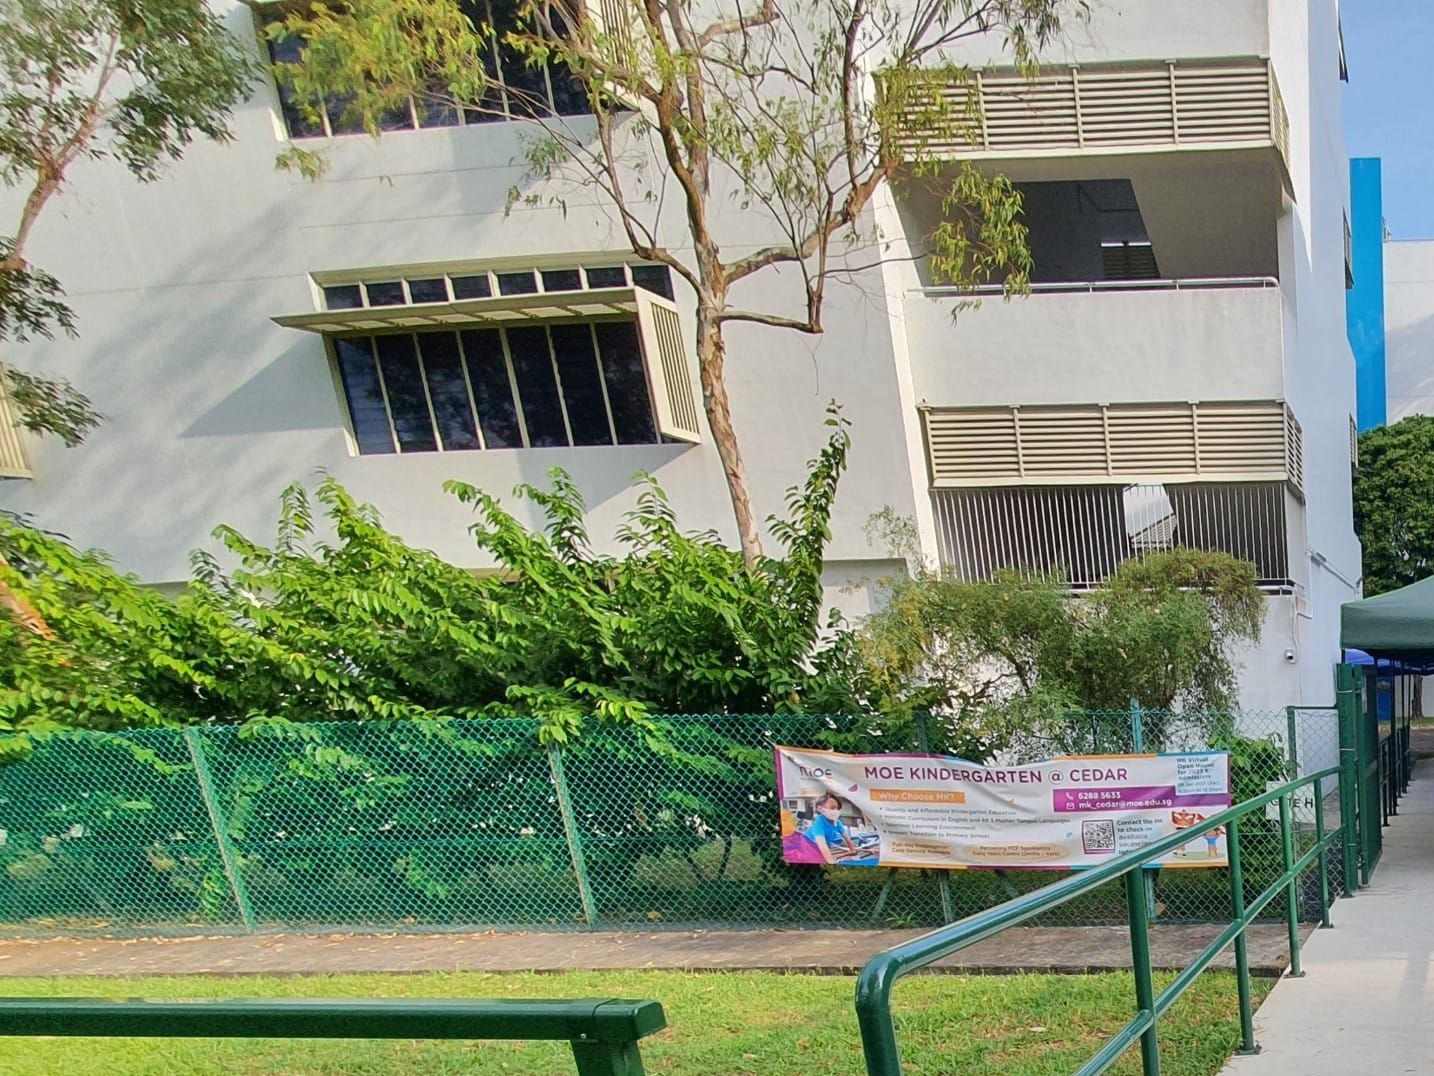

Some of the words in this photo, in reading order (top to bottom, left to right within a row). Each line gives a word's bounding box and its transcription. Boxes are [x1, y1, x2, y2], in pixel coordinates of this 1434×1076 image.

[864, 766, 904, 780] MOE
[910, 767, 1041, 783] KINDERGARTEN
[1048, 770, 1064, 785] @
[1070, 768, 1128, 782] CEDAR
[879, 792, 898, 801] Why
[901, 792, 934, 801] Choose
[936, 793, 954, 802] MK?
[1078, 792, 1099, 800] 6288
[1100, 791, 1121, 799] 5633
[1079, 799, 1172, 810] mk_cedar@moe.edu.sg
